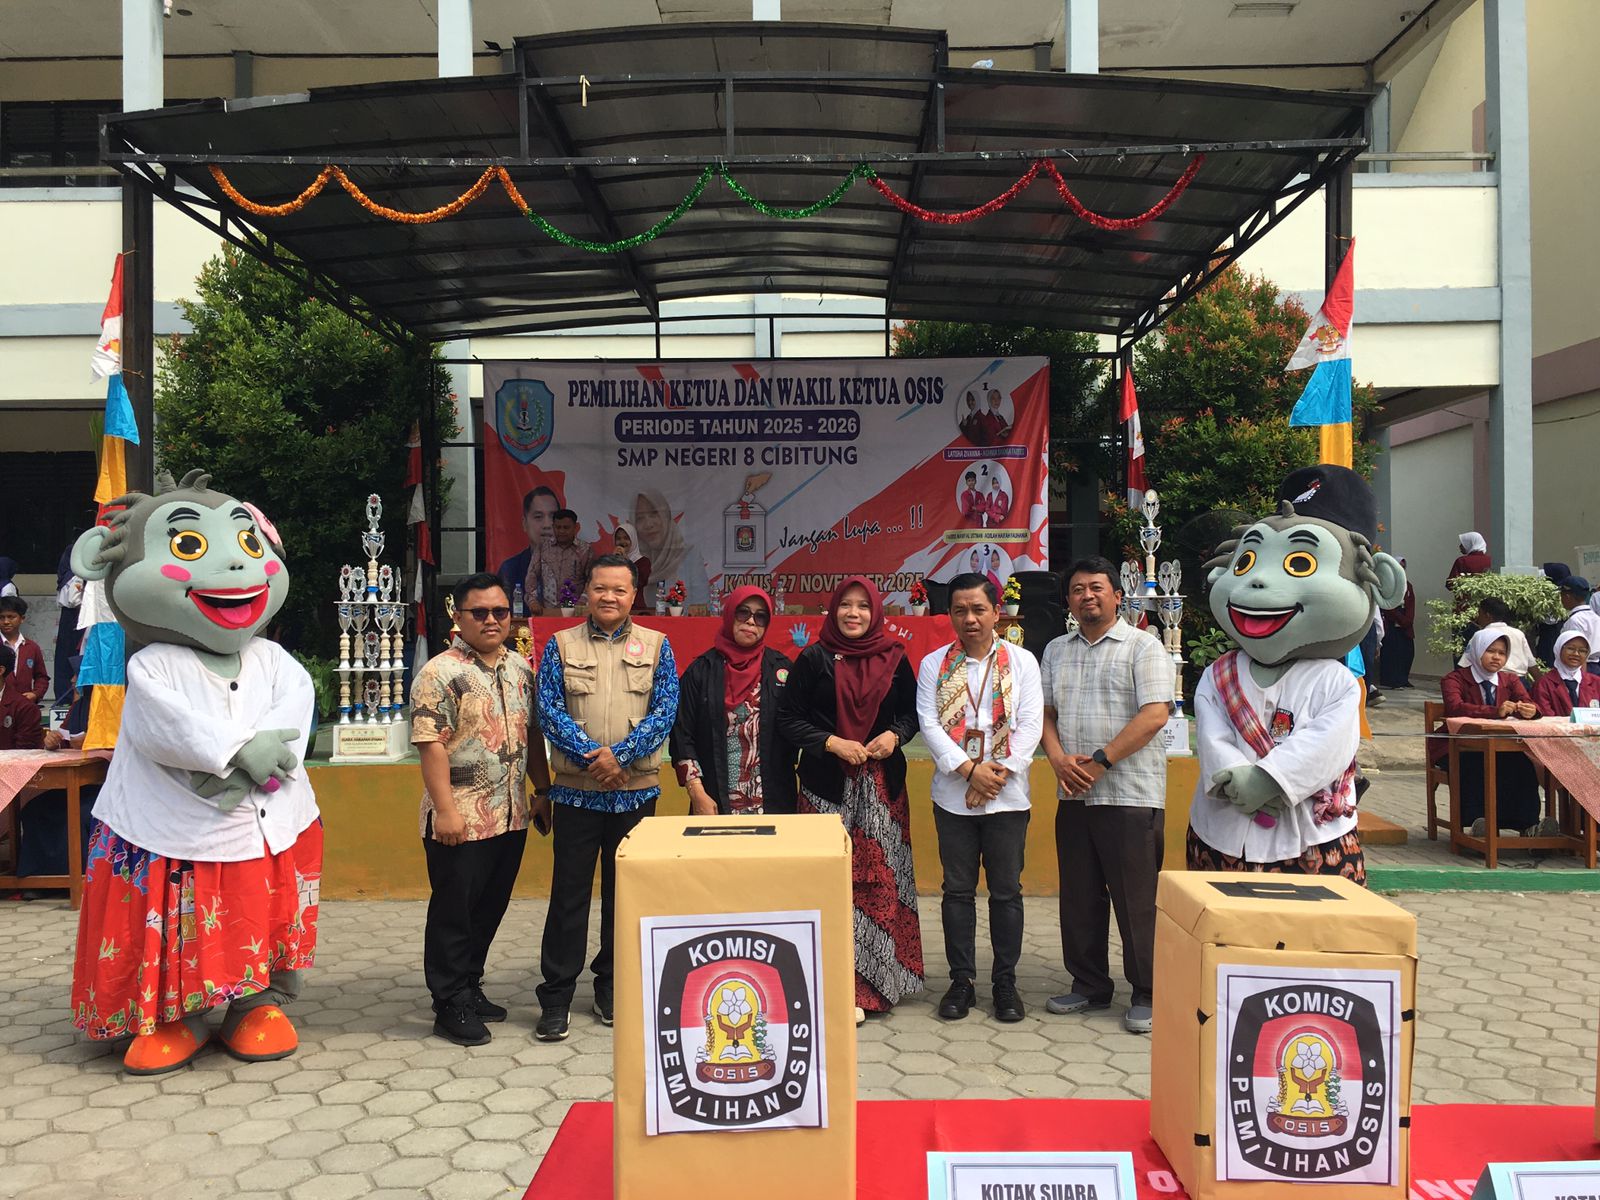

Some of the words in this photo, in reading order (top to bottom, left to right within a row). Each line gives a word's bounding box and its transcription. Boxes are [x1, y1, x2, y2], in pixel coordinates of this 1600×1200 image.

[567, 379, 666, 408] PEMILIHAN
[669, 378, 731, 407] KETUA
[734, 377, 772, 406] DAN
[776, 377, 836, 406] WAKIL
[839, 376, 901, 405] KETUA
[904, 376, 944, 405] OSIS
[621, 419, 695, 436] PERIODE
[700, 418, 758, 435] TAHUN
[763, 417, 803, 434] 2025
[817, 417, 857, 434] 2026
[617, 448, 659, 467] SMP
[664, 447, 737, 467] NEGERI
[743, 447, 755, 466] 8
[761, 446, 858, 466] CIBITUNG
[981, 464, 988, 476] 2
[780, 526, 839, 554] Jangan
[843, 515, 881, 544] Lupa
[983, 544, 990, 556] 3
[778, 573, 797, 593] 27
[688, 937, 776, 967] KOMISI
[1264, 992, 1354, 1021] KOMISI
[661, 1029, 781, 1120] PEMILIHAN
[784, 1023, 809, 1099] OSIS
[713, 1066, 759, 1080] OSIS
[1232, 1077, 1351, 1173] PEMILIHAN
[1356, 1082, 1383, 1155] OSIS
[1284, 1119, 1330, 1133] OSIS
[981, 1183, 1036, 1200] KOTAK
